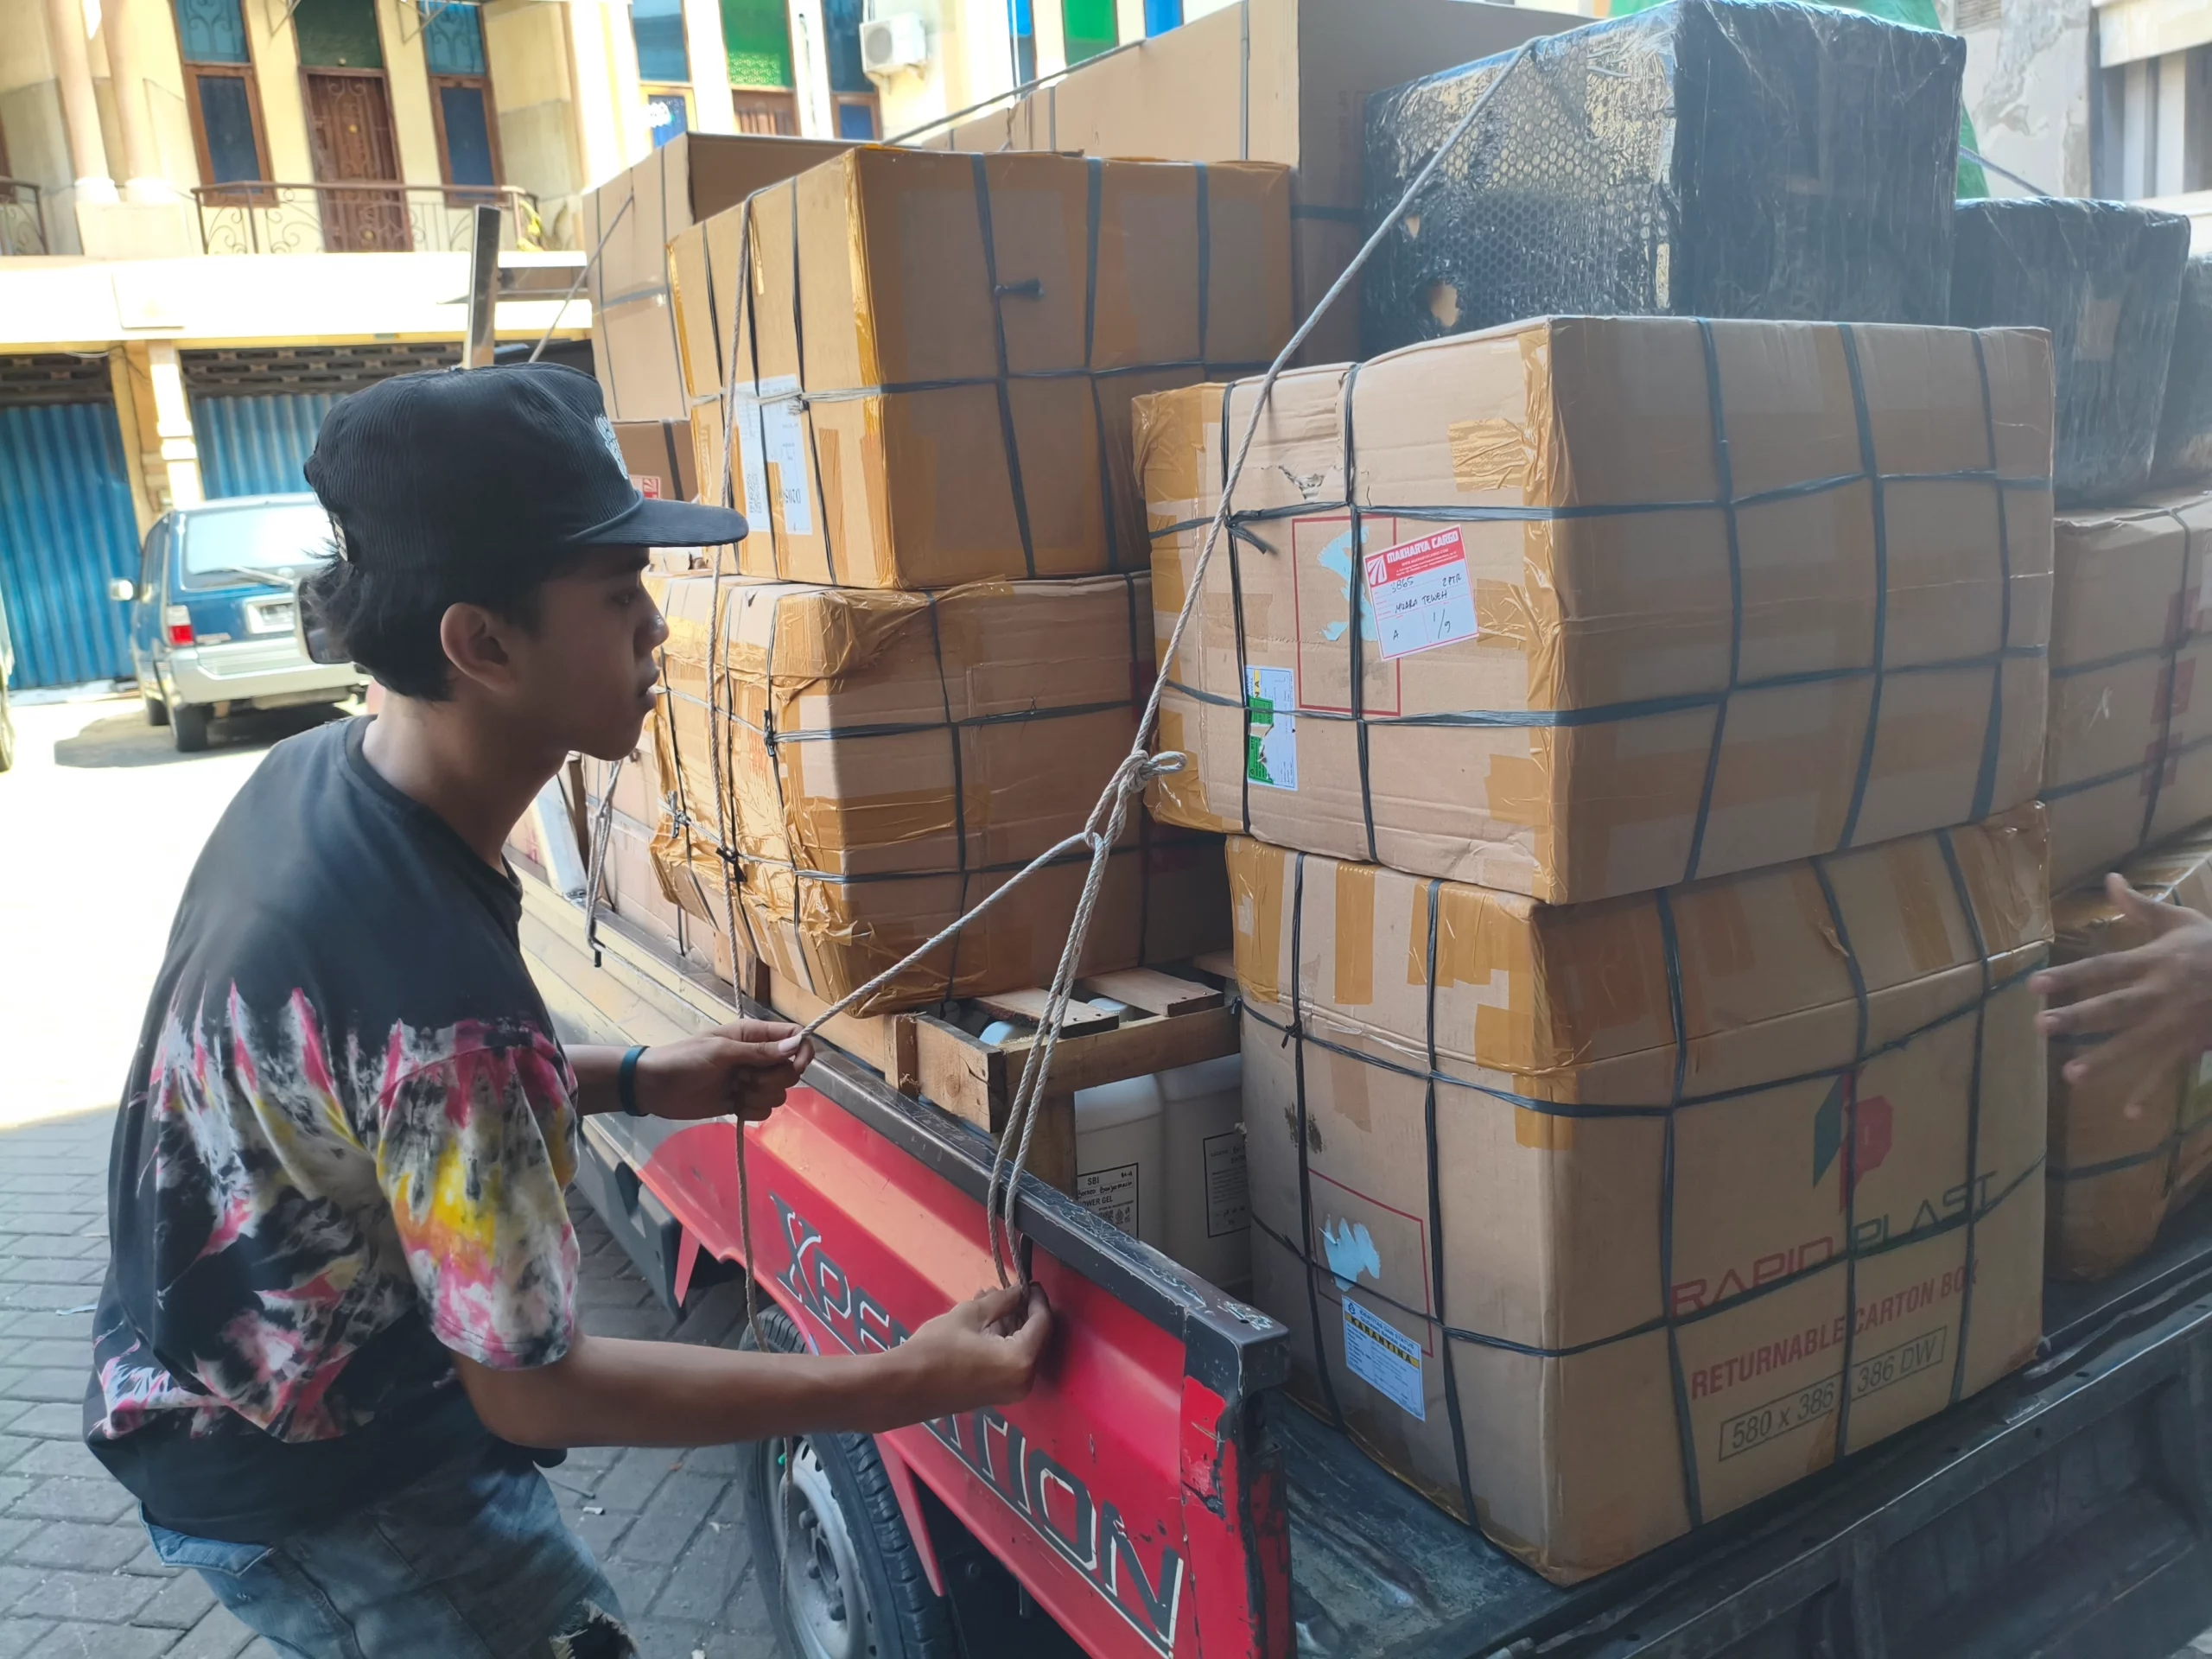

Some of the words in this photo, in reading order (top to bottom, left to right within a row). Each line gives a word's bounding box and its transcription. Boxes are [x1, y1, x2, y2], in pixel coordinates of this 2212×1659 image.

[1386, 541, 1431, 563] MAKHARYA
[1431, 531, 1459, 549] CARGO
[1395, 599, 1418, 613] MUARA
[1421, 589, 1448, 606] TEWEH
[1392, 629, 1400, 640] A
[1087, 1176, 1100, 1186] SBI
[1102, 1196, 1114, 1205] GEL
[1670, 1236, 1834, 1319] RAPID
[1853, 1170, 1998, 1252] PLAST
[1351, 1316, 1413, 1365] KARANTINA
[1691, 1316, 1846, 1401] RETURNABLE
[1853, 1278, 1936, 1337] CARTON
[1732, 1409, 1770, 1450] 580
[1778, 1408, 1790, 1430] x
[1797, 1382, 1834, 1421] 386
[1858, 1355, 1895, 1393] 386
[1899, 1336, 1936, 1376] DW
